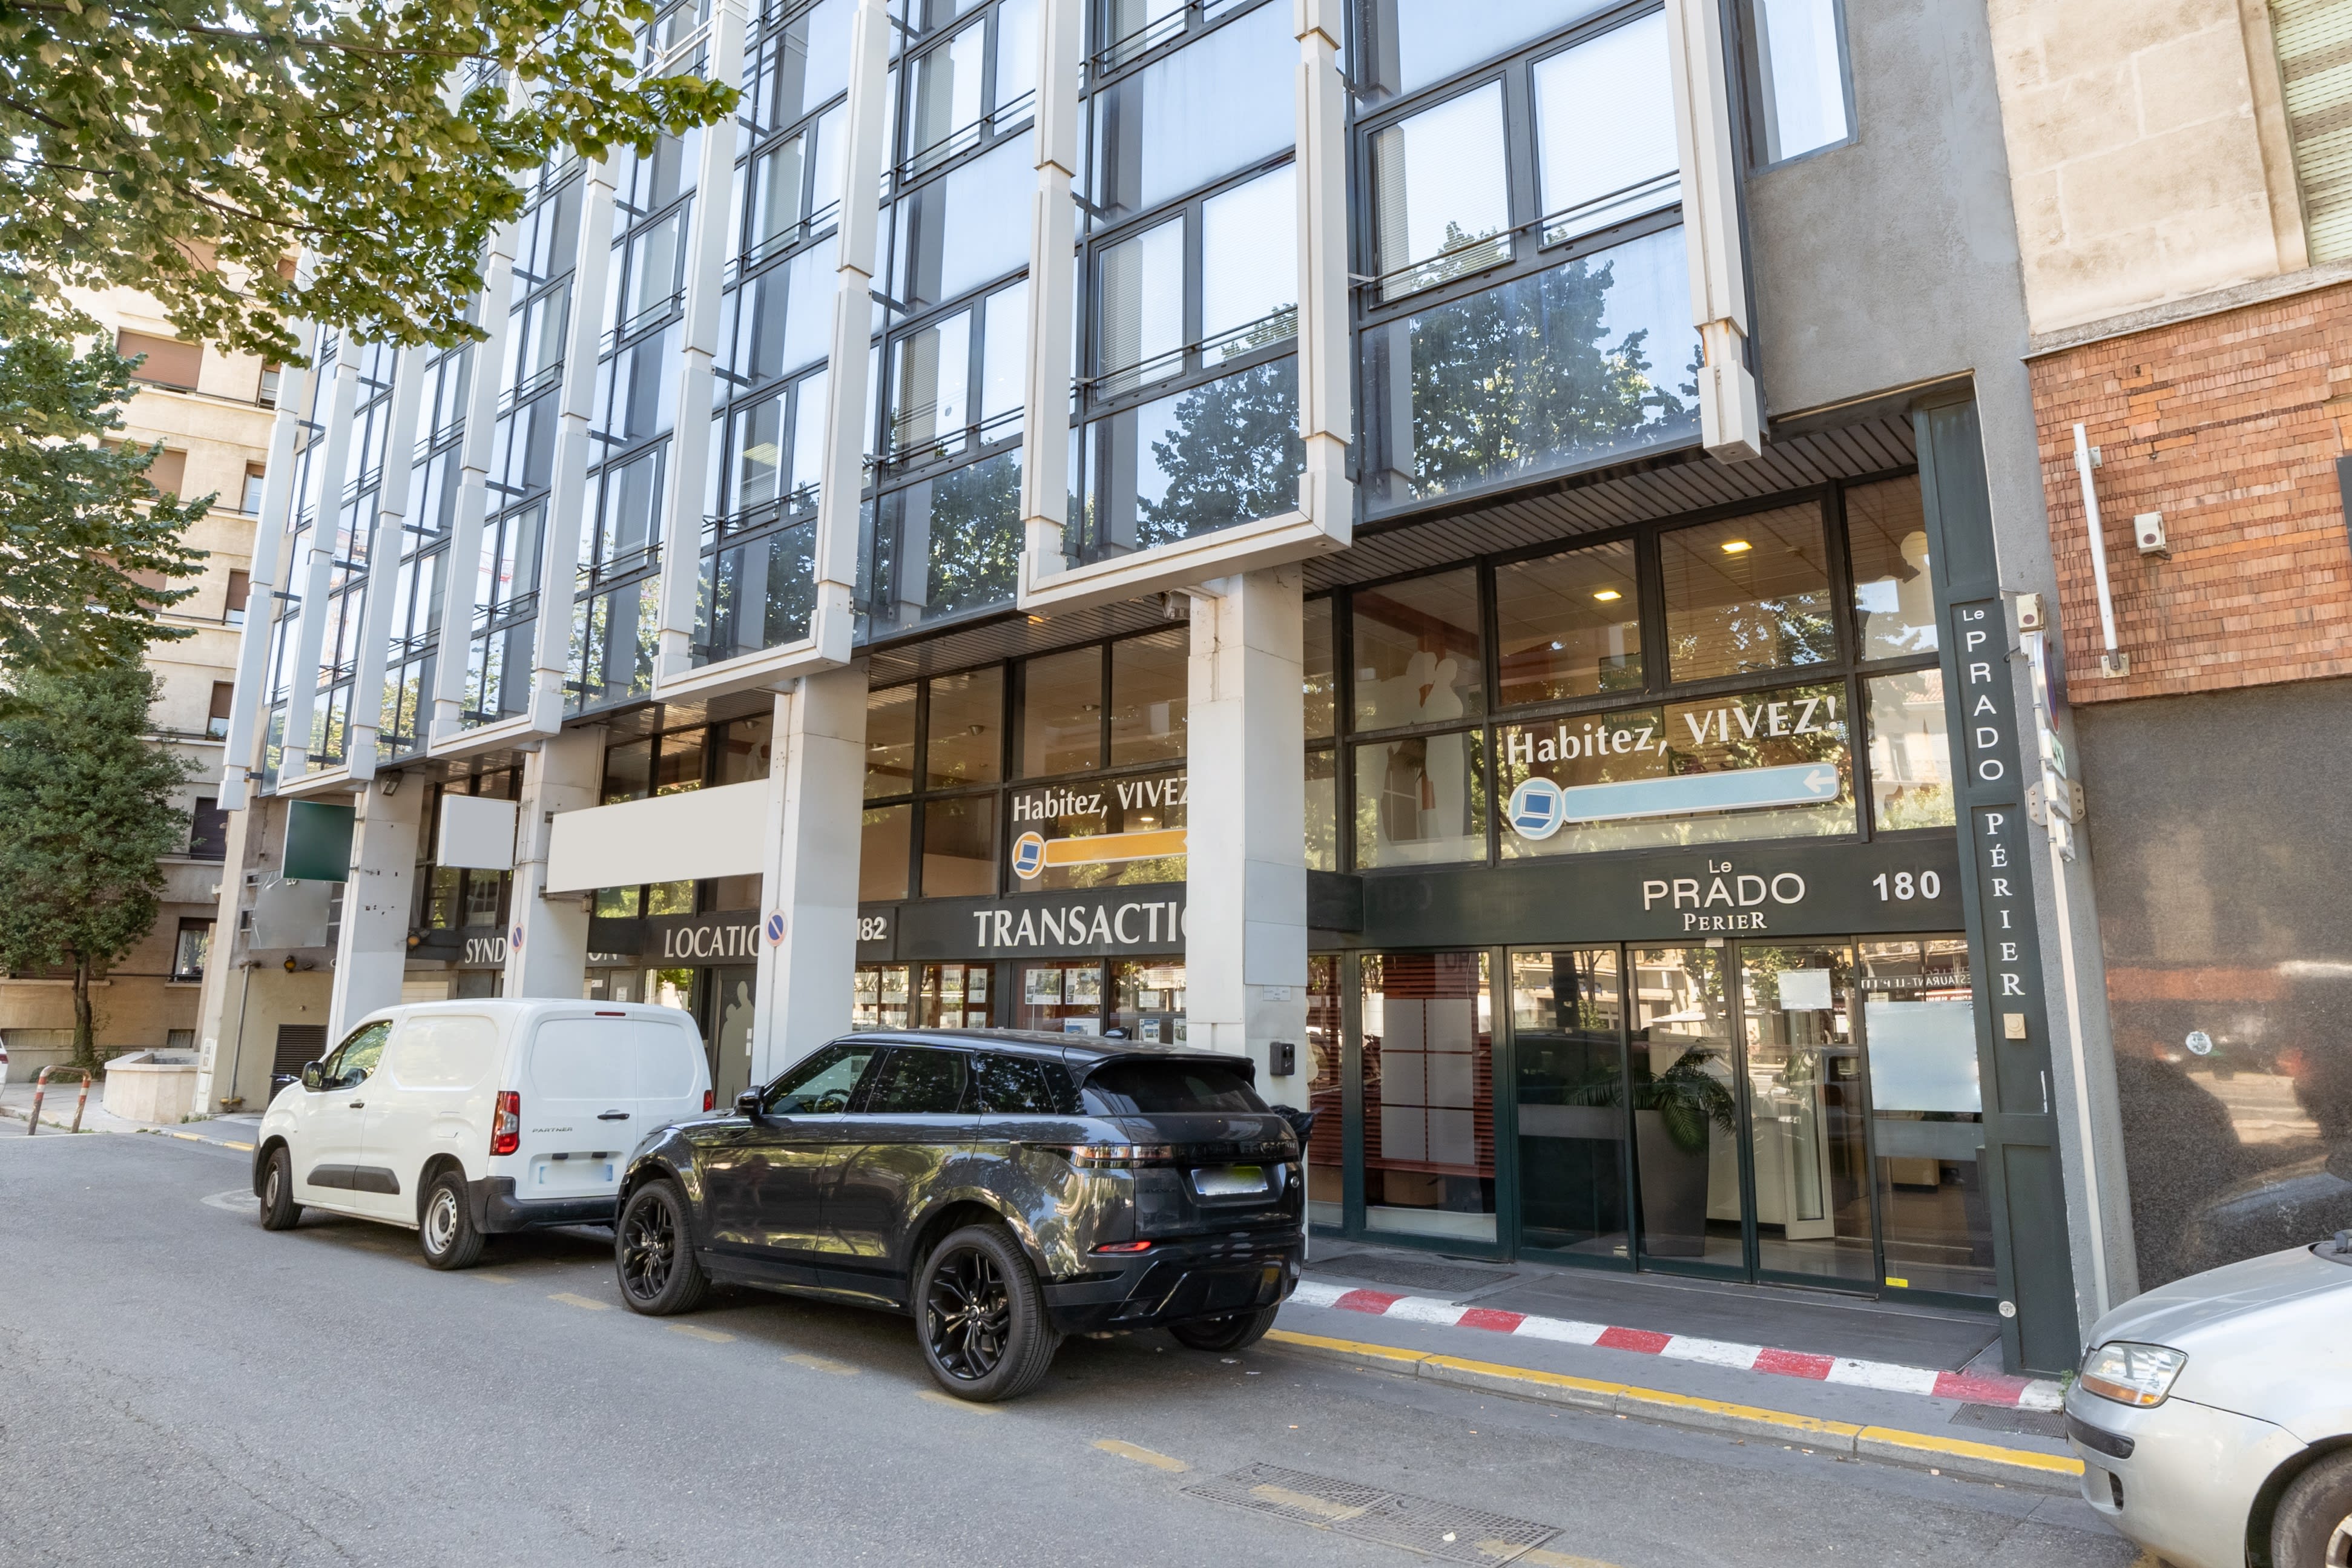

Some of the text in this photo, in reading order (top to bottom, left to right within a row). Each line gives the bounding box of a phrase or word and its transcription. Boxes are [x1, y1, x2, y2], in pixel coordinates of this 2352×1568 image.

[1963, 609, 1985, 622] Le
[1966, 630, 2004, 781] PRADO
[1506, 695, 1839, 765] Habitez, VIVEZ!
[1013, 788, 1108, 822] Habitez,
[1708, 859, 1733, 874] Le
[1642, 872, 1806, 911] PRADO
[1873, 871, 1941, 901] 180
[1985, 812, 2026, 996] PÉRIER
[973, 901, 1187, 947] TRANSACTI
[1682, 911, 1768, 932] PERIER
